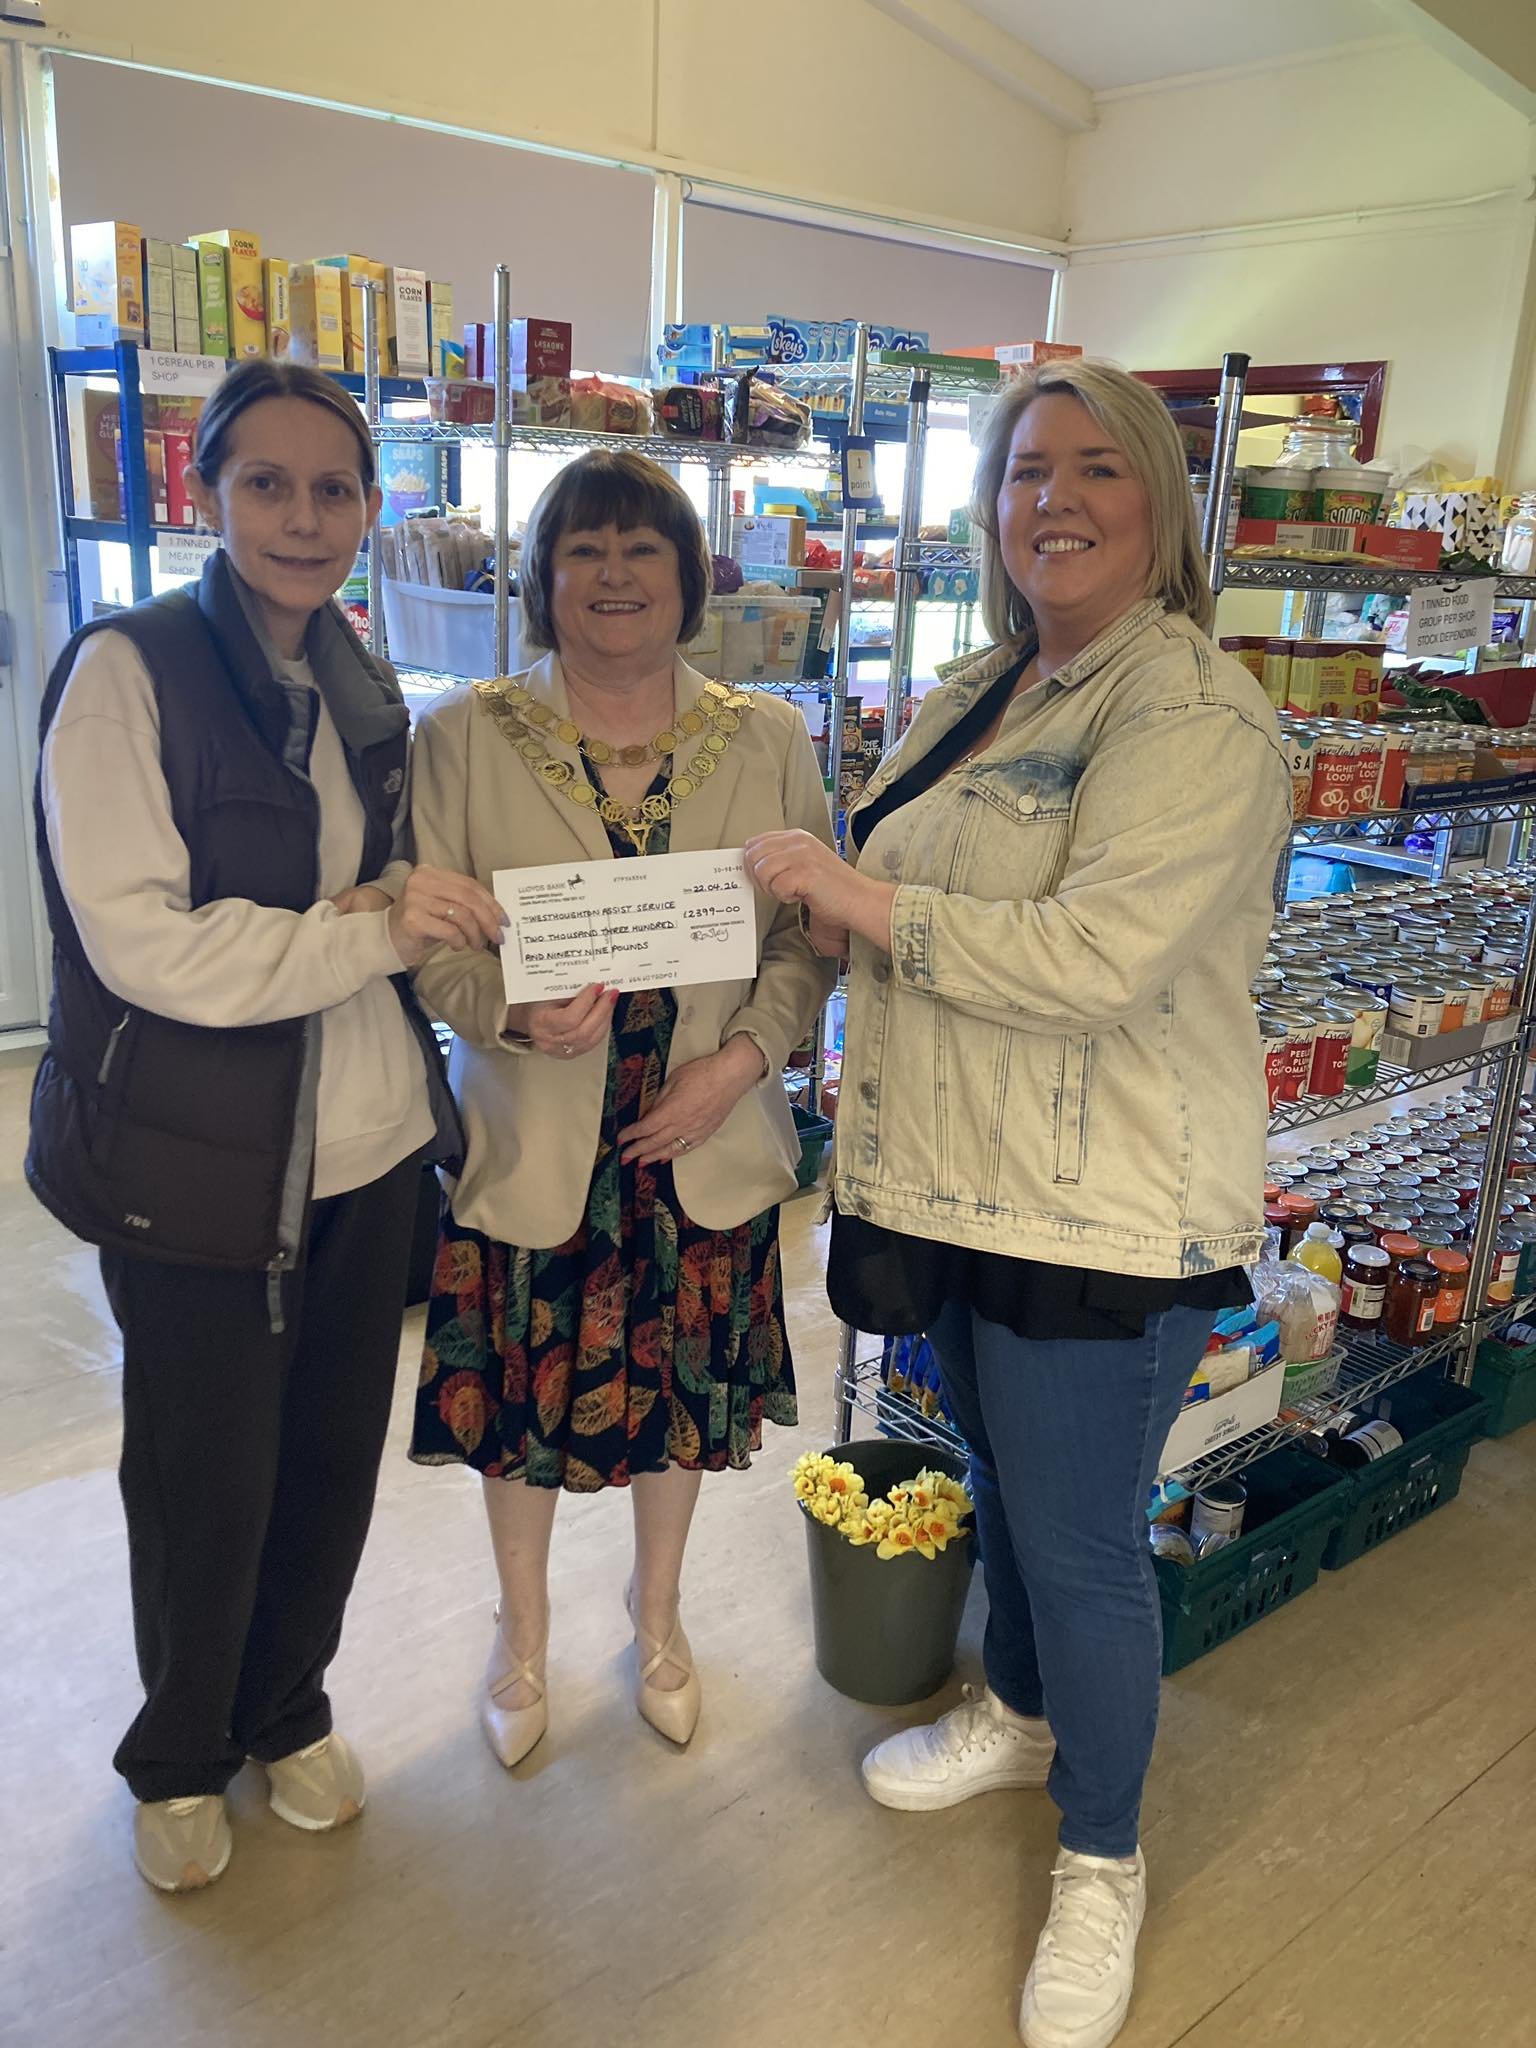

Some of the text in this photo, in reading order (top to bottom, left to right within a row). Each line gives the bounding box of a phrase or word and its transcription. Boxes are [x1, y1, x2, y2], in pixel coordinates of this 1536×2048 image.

[234, 239, 254, 249] CORN
[232, 247, 257, 257] FLAKES
[399, 287, 422, 296] CORN
[399, 294, 423, 302] FLAKES
[534, 340, 565, 351] LASAGNE
[150, 357, 216, 369] 1 CEREAL PER
[945, 363, 975, 373] TOMATOES
[151, 371, 179, 382] SHOP
[392, 449, 424, 461] SNAPS
[857, 458, 862, 469] 1
[440, 449, 448, 504] RICE SNAPS
[851, 481, 871, 490] point
[176, 538, 211, 549] TINNED
[168, 552, 193, 561] MEAT
[168, 567, 196, 576] SHOP
[1426, 597, 1450, 609] TINNED
[1452, 593, 1469, 605] FOOD
[1419, 610, 1476, 629] GROUP PER SHOP
[1417, 627, 1477, 647] STOCK DEPENDING
[1318, 744, 1356, 756] ssentials
[1326, 773, 1354, 782] LOOPS
[547, 882, 566, 891] BANK
[693, 881, 739, 893] 22.04.26
[529, 901, 676, 922] WESTHOUGHTON ASSIST SERVICE
[523, 921, 675, 944] TWO THOUSAND THREE HUNDRED
[525, 942, 649, 962] AND NINETY NINE POUNDS
[1290, 1050, 1310, 1058] PEEL
[1280, 1064, 1308, 1074] OMAT
